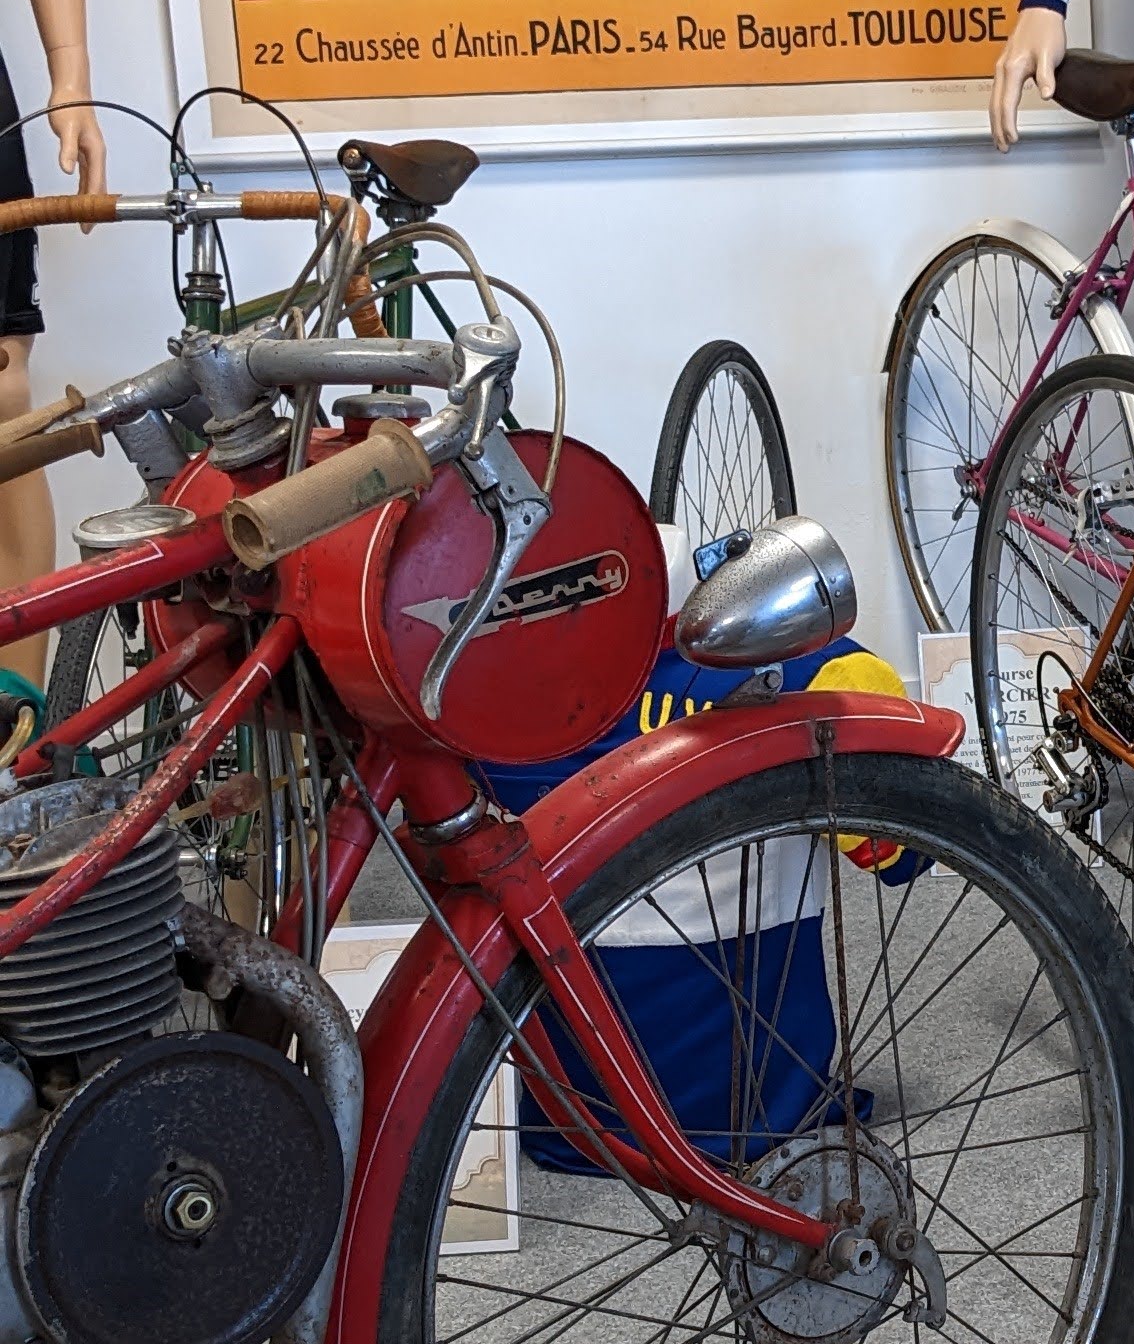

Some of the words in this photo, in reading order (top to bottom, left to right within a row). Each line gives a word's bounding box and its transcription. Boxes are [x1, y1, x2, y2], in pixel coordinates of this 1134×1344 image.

[254, 43, 284, 65] 22
[676, 15, 726, 52] Rue
[848, 6, 1009, 46] TOULOUSE
